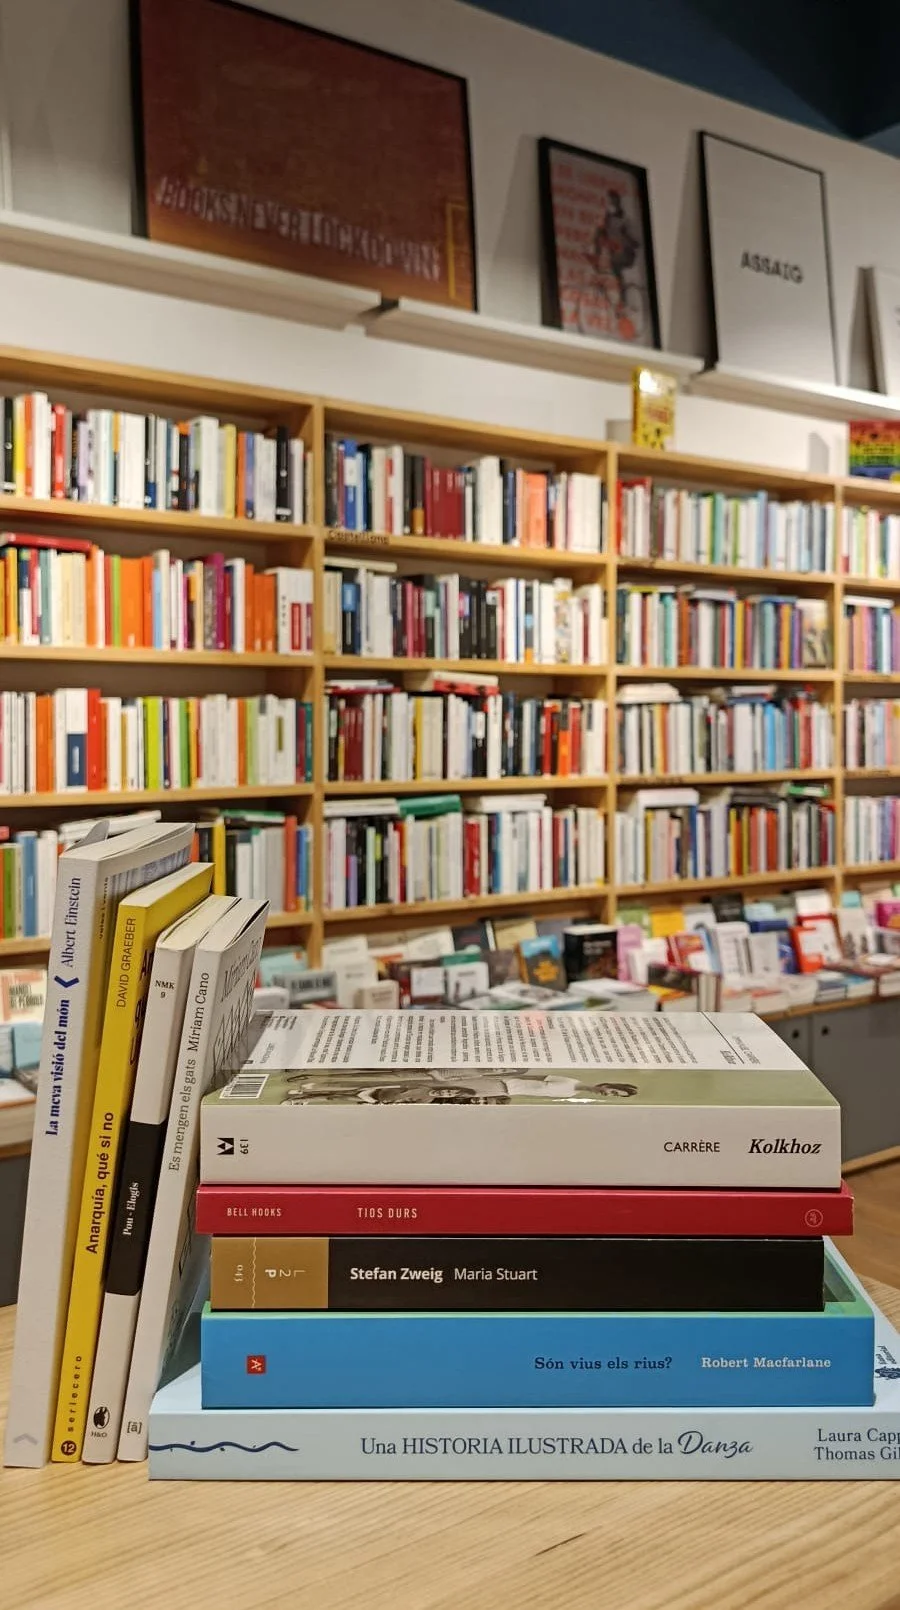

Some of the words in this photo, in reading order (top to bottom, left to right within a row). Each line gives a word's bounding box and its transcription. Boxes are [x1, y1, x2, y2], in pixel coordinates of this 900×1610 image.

[740, 251, 804, 284] ASSAIG
[65, 877, 82, 926] Einstein
[61, 930, 77, 968] Albert
[121, 917, 137, 971] GRAEBER
[116, 974, 130, 1008] DAVID
[155, 979, 175, 990] NMK
[195, 972, 210, 1005] Cano
[56, 999, 70, 1028] món
[187, 1007, 205, 1052] Míriam
[53, 1030, 67, 1051] del
[50, 1052, 65, 1082] visió
[184, 1058, 196, 1085] gats
[49, 1085, 63, 1117] meva
[179, 1084, 192, 1104] els
[45, 1120, 59, 1137] La
[102, 1112, 115, 1132] no
[173, 1104, 190, 1156] mengen
[98, 1135, 112, 1149] si
[239, 1139, 249, 1155] 139
[663, 1139, 721, 1153] CARRÈRE
[748, 1138, 822, 1155] Kolkhoz
[96, 1151, 111, 1180] qué
[169, 1156, 180, 1172] Es
[126, 1181, 141, 1211] Elogis
[85, 1184, 109, 1254] Anarquía,
[226, 1207, 248, 1217] BELL
[251, 1207, 282, 1218] HOOKS
[357, 1207, 383, 1218] TIOS
[388, 1208, 418, 1219] DURS
[122, 1217, 134, 1236] Pou
[350, 1267, 397, 1280] Stefan
[400, 1267, 444, 1284] Zweig
[454, 1267, 493, 1281] Maria
[496, 1267, 538, 1281] Stuart
[534, 1355, 564, 1370] Són
[570, 1356, 601, 1370] vius
[607, 1357, 629, 1370] els
[634, 1356, 673, 1370] rius?
[701, 1356, 749, 1369] Robert
[753, 1356, 832, 1369] Macfarlane
[360, 1437, 396, 1455] Una
[402, 1437, 502, 1455] HISTORIA
[507, 1437, 627, 1455] ILUSTRADA
[632, 1437, 653, 1455] de
[658, 1437, 673, 1455] la
[678, 1430, 754, 1459] Danza
[817, 1428, 862, 1442] Laura
[63, 1441, 75, 1454] 12
[813, 1446, 876, 1461] Thomas
